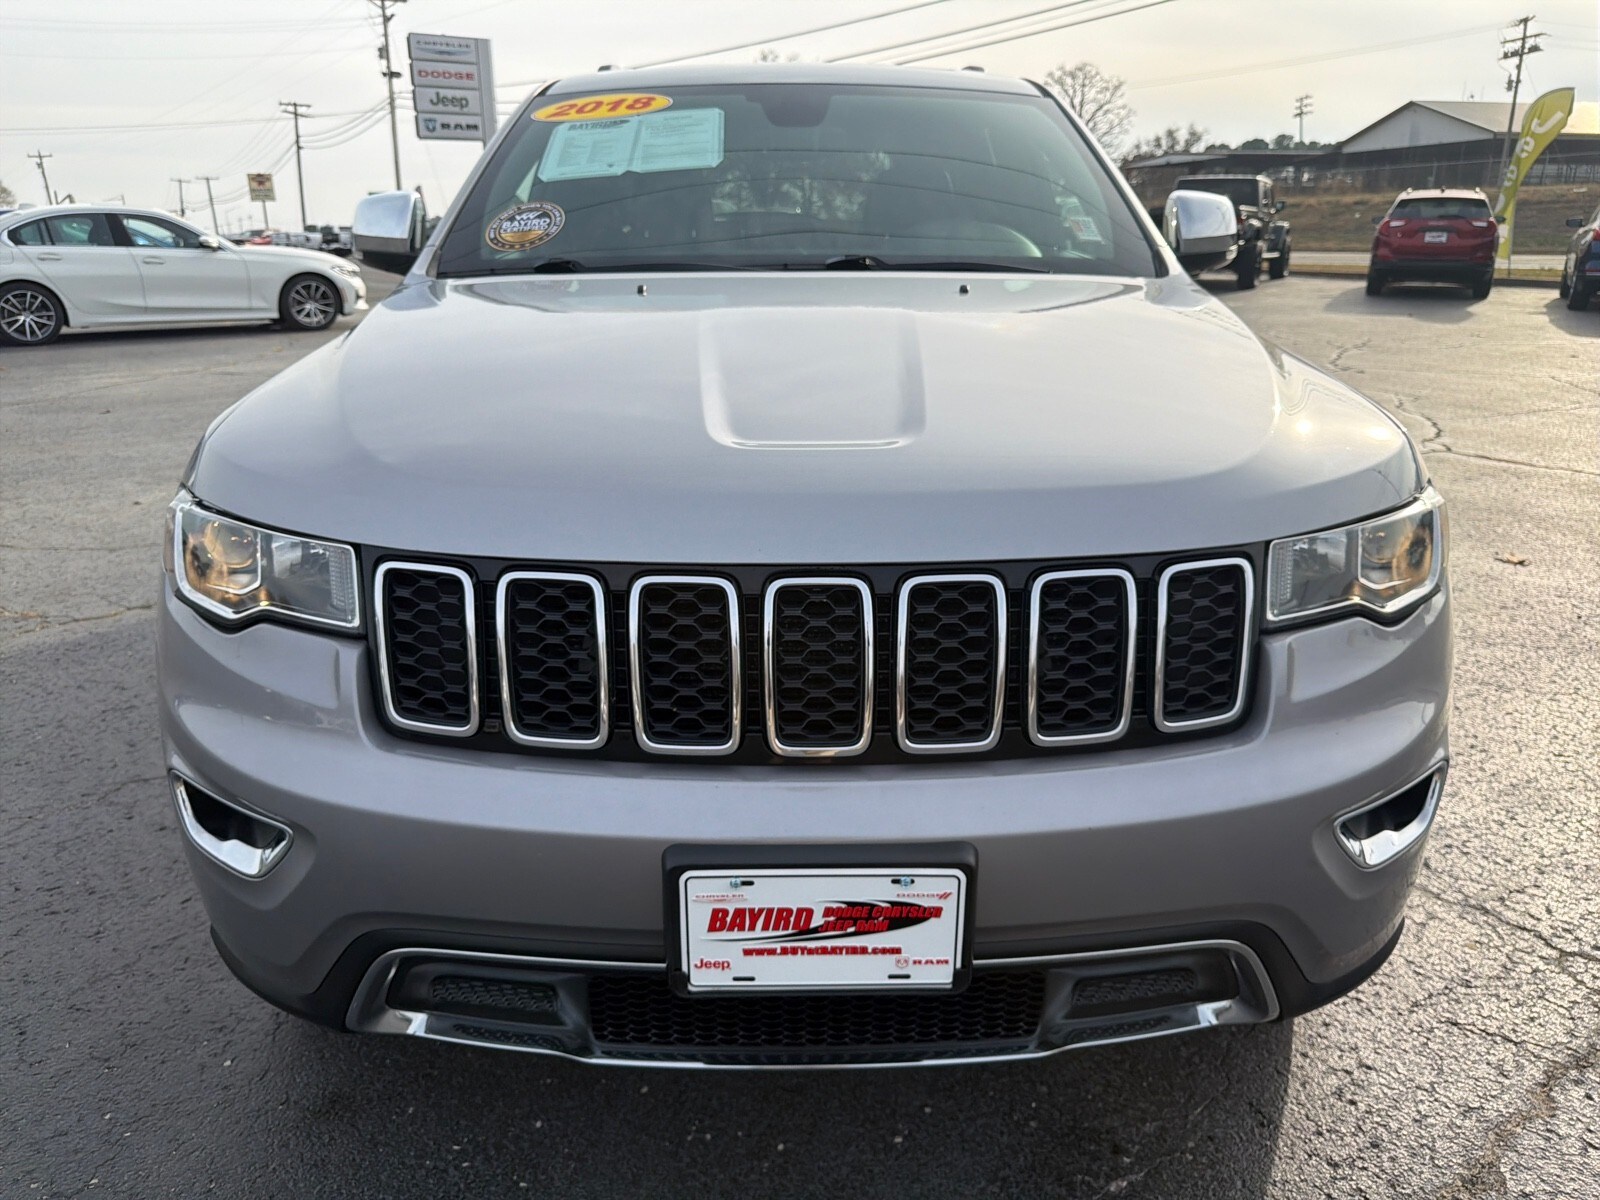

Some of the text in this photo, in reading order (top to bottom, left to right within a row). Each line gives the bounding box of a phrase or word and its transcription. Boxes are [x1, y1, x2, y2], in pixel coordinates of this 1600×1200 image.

[417, 70, 475, 81] DODGE
[429, 91, 470, 109] Jeep
[545, 96, 656, 119] 2018
[440, 122, 479, 131] RAM
[502, 217, 551, 229] BAYIRD
[500, 225, 549, 234] CERTIFIED
[822, 906, 943, 918] DODGE CHRYSLER
[707, 907, 815, 933] BAYIRD
[818, 920, 890, 933] JEEP RAM
[694, 958, 731, 970] Jeep
